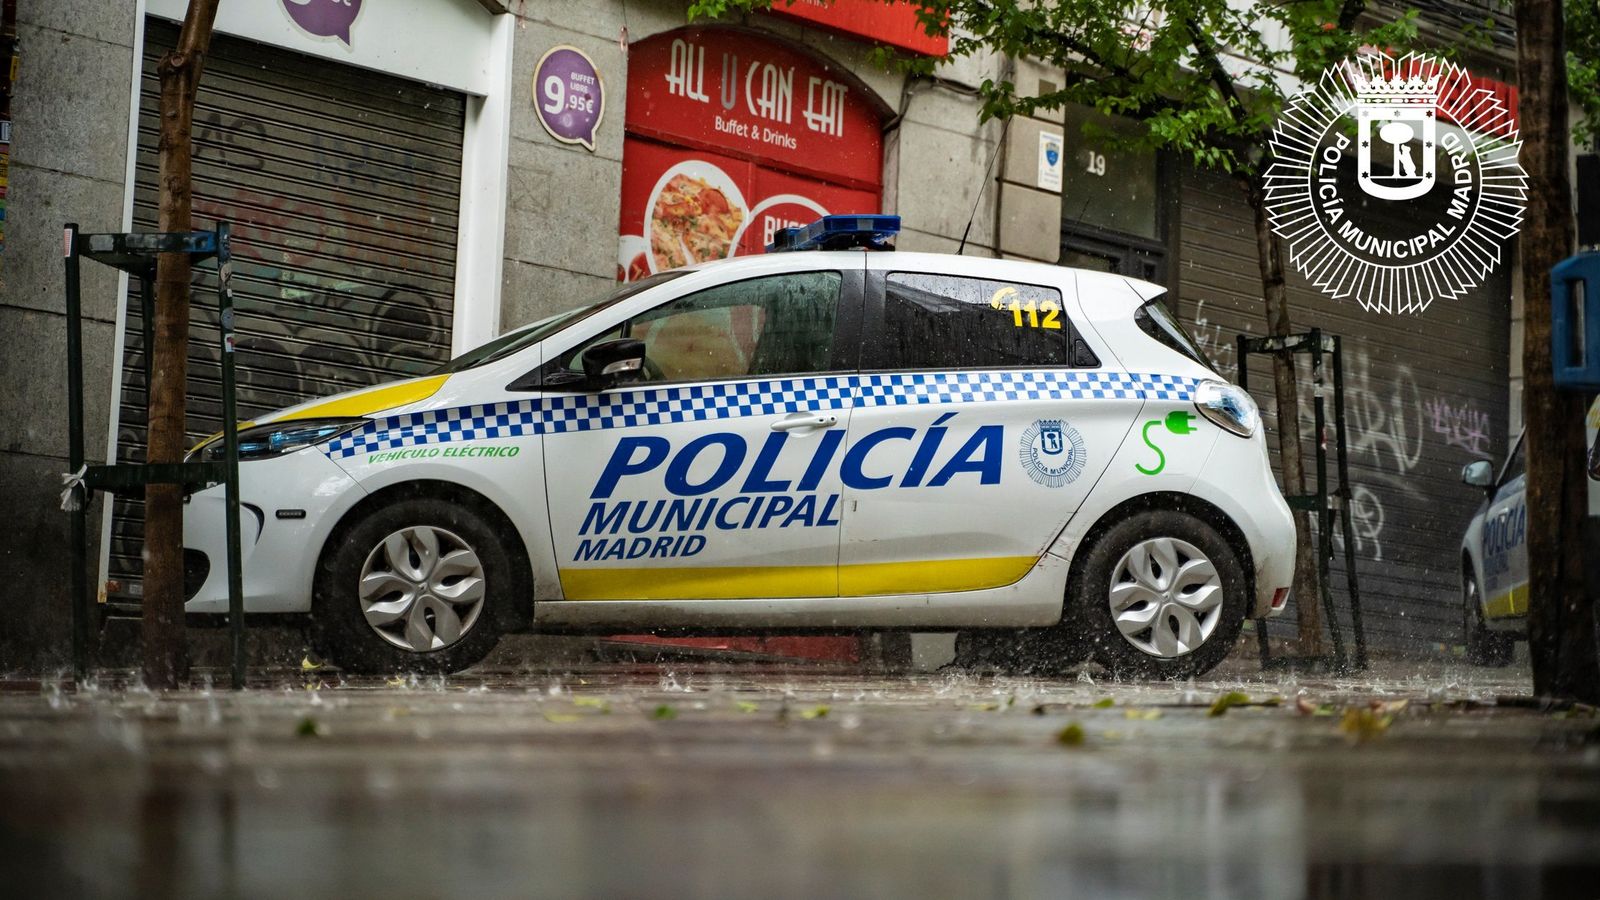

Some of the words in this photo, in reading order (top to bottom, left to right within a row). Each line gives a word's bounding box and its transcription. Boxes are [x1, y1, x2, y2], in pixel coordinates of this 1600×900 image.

[569, 81, 589, 94] LIBRE
[570, 72, 595, 86] BUFFET
[665, 38, 710, 104] ALL
[721, 52, 738, 111] U
[745, 60, 795, 125] CAN
[802, 76, 848, 138] EAT
[715, 116, 749, 138] Buffet
[751, 125, 760, 141] &
[763, 128, 797, 150] Drinks
[1086, 151, 1106, 177] 19
[1008, 299, 1061, 329] 112
[368, 447, 440, 465] VEHÍCULO
[442, 444, 520, 458] ELÉCTRICO
[589, 412, 1004, 499] POLICÍA
[578, 494, 839, 536] MUNICIPAL
[573, 535, 707, 562] MADRID
